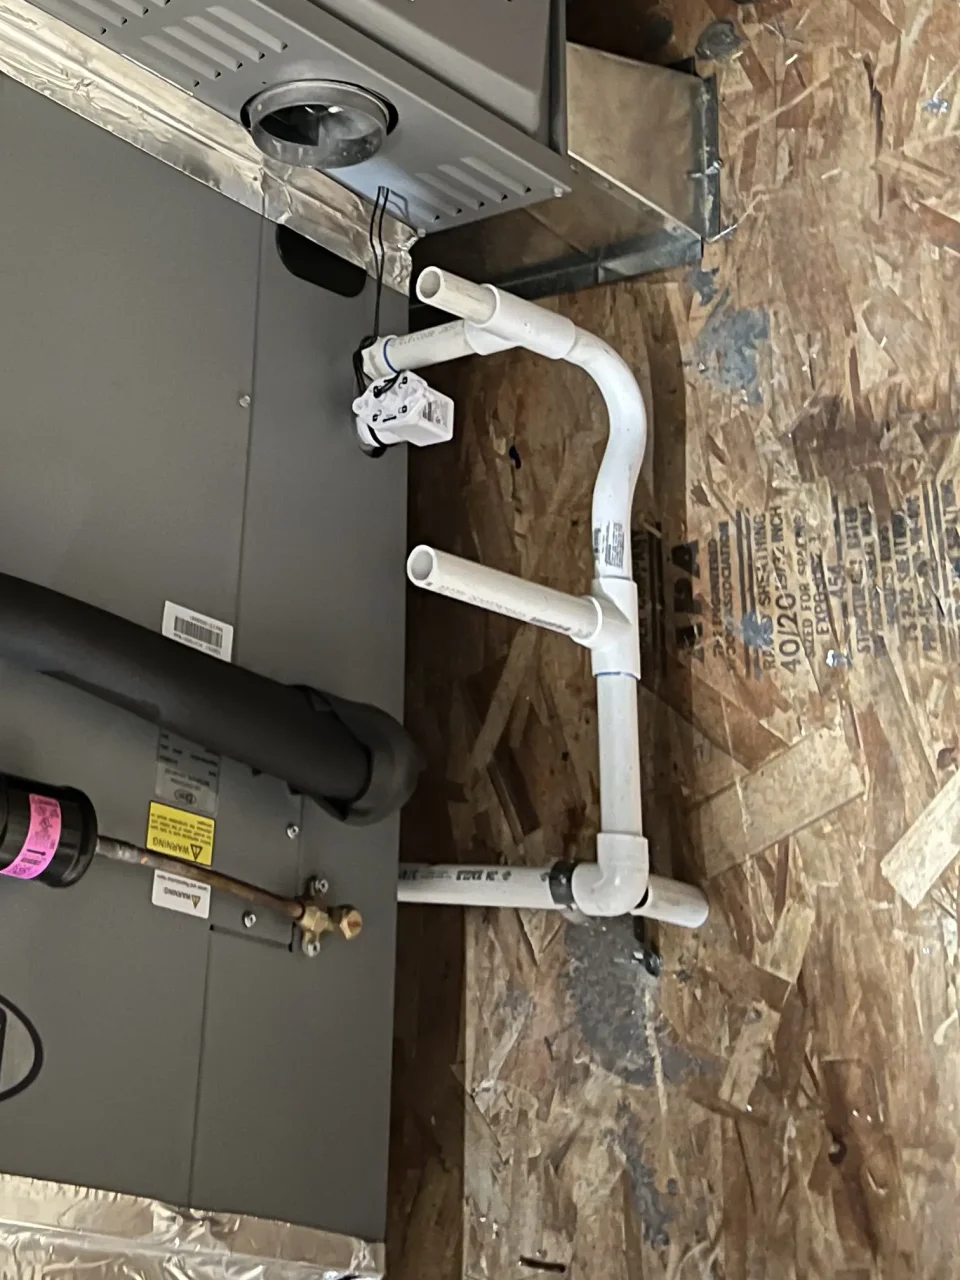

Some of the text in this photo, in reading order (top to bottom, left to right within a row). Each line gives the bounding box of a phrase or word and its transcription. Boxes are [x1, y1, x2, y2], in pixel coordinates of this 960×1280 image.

[768, 505, 784, 543] INCH
[669, 538, 704, 662] APA
[798, 582, 811, 612] FOR
[826, 562, 847, 600] 454
[773, 591, 802, 675] 40/20
[801, 618, 815, 658] SIZED
[151, 835, 188, 855] WARNING
